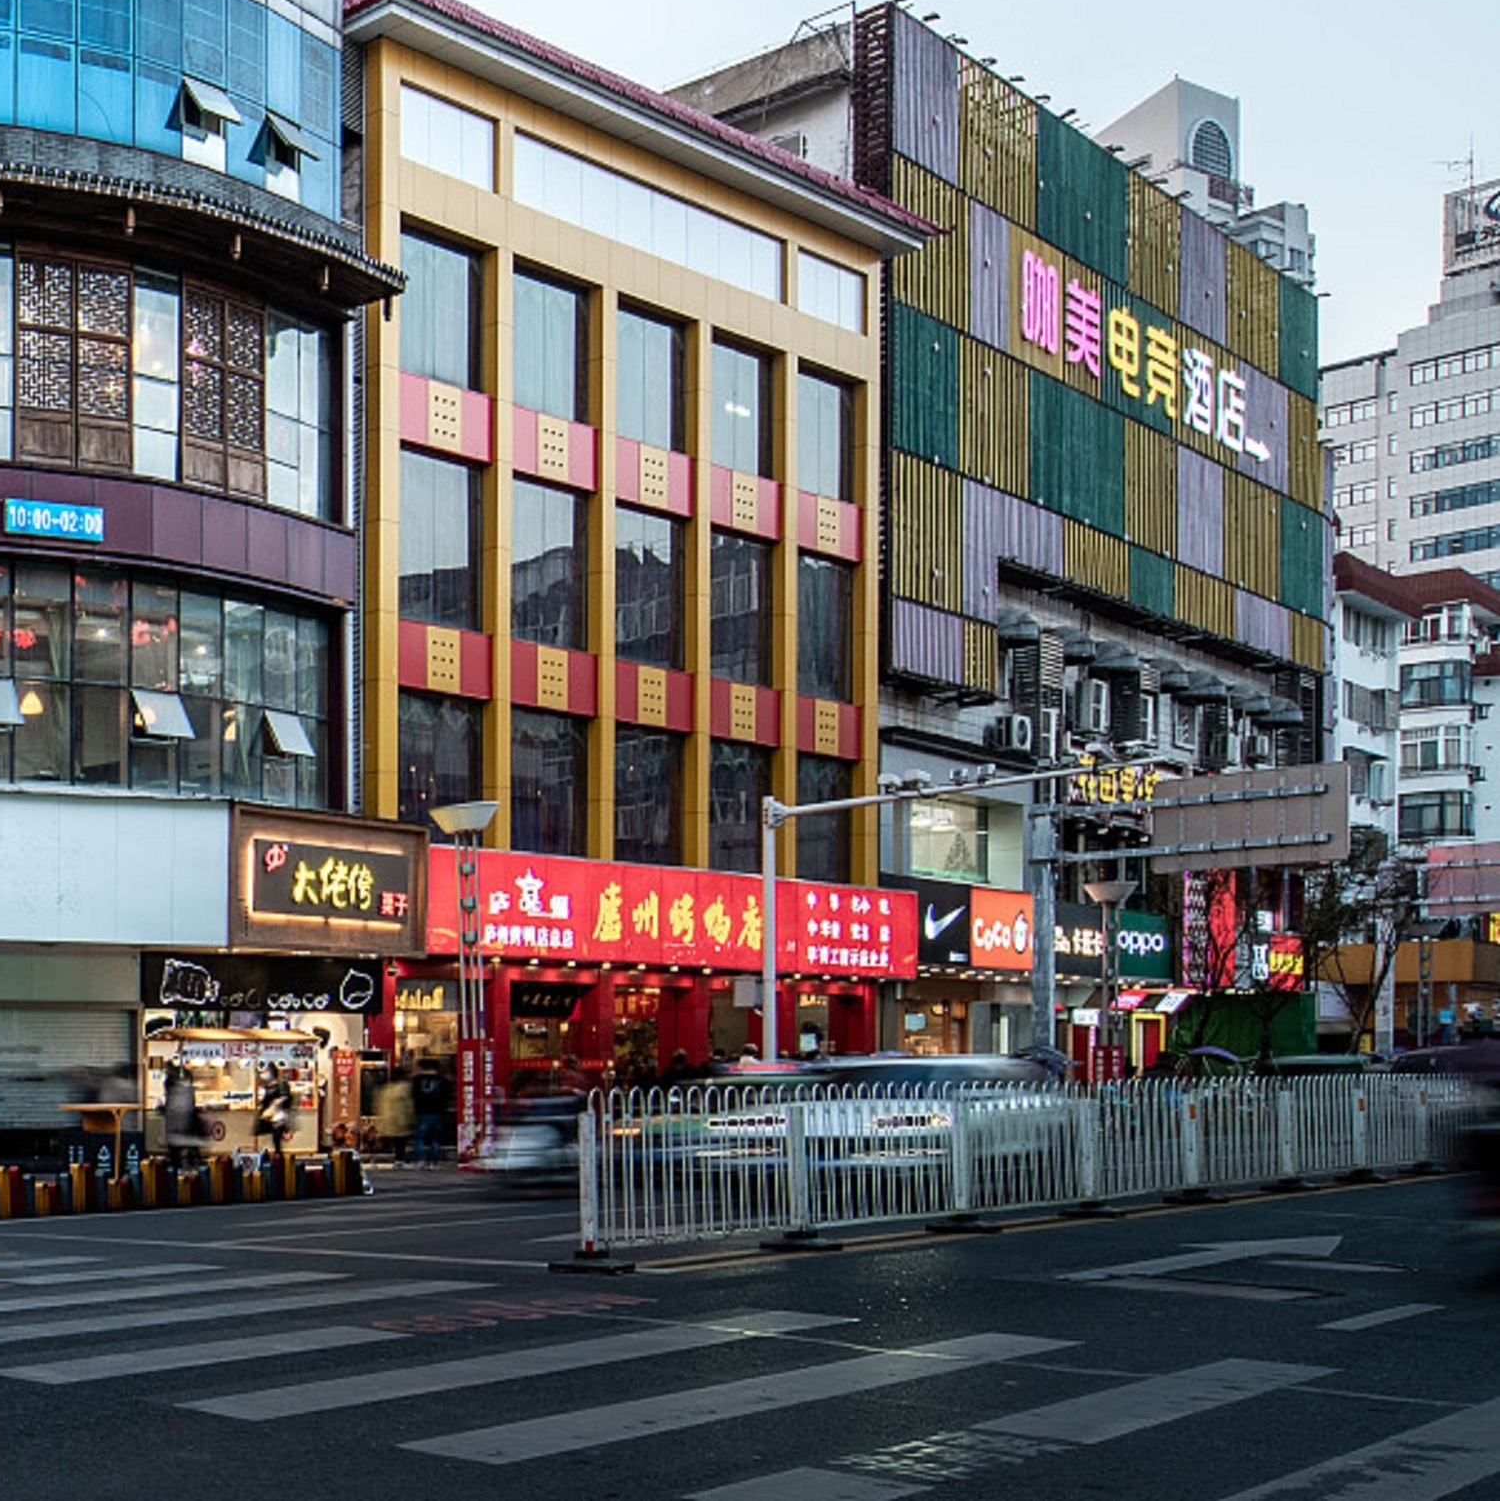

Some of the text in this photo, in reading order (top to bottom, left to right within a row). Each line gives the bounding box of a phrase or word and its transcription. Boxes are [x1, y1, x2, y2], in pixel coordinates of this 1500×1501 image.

[1020, 249, 1247, 454] 咖美电竞酒店
[9, 506, 103, 535] 10:00-02:00
[972, 917, 1011, 951] CoCo
[1117, 930, 1165, 955] oppo
